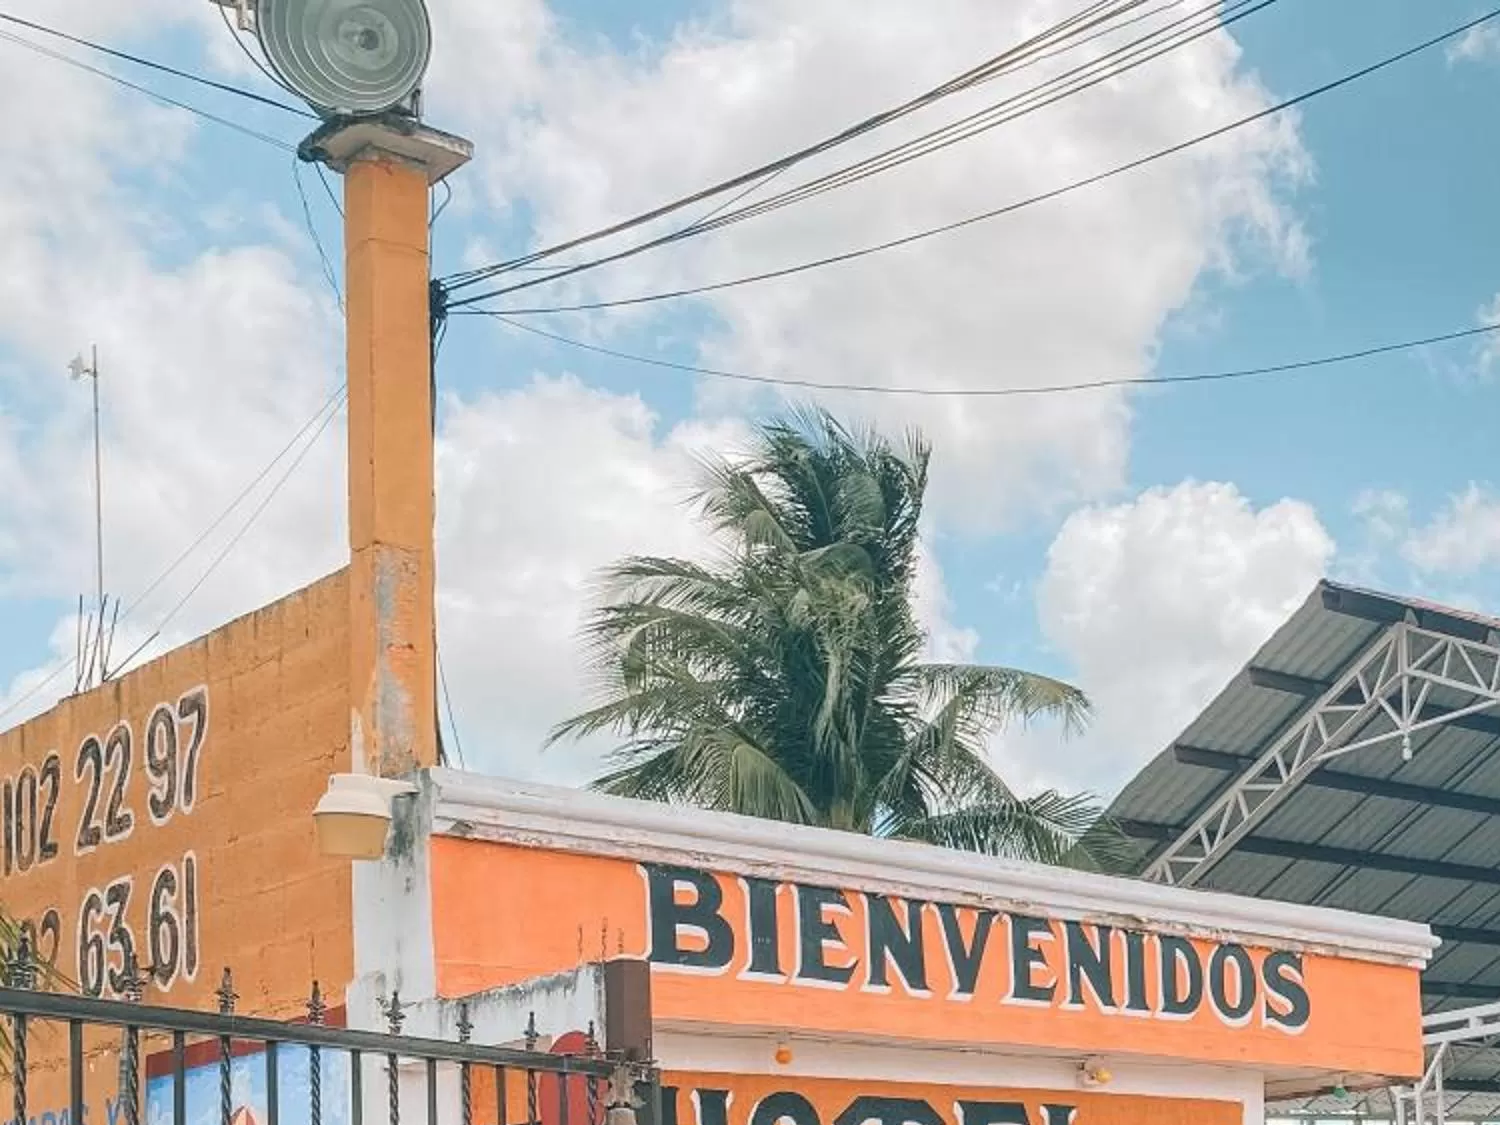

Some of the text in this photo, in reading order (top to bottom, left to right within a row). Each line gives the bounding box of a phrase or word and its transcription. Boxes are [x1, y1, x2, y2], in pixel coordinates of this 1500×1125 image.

[75, 719, 135, 855] 22
[145, 684, 209, 826] 97
[77, 875, 136, 998] 63
[148, 850, 197, 992] 61
[637, 862, 1312, 1036] BIENVENIDOS
